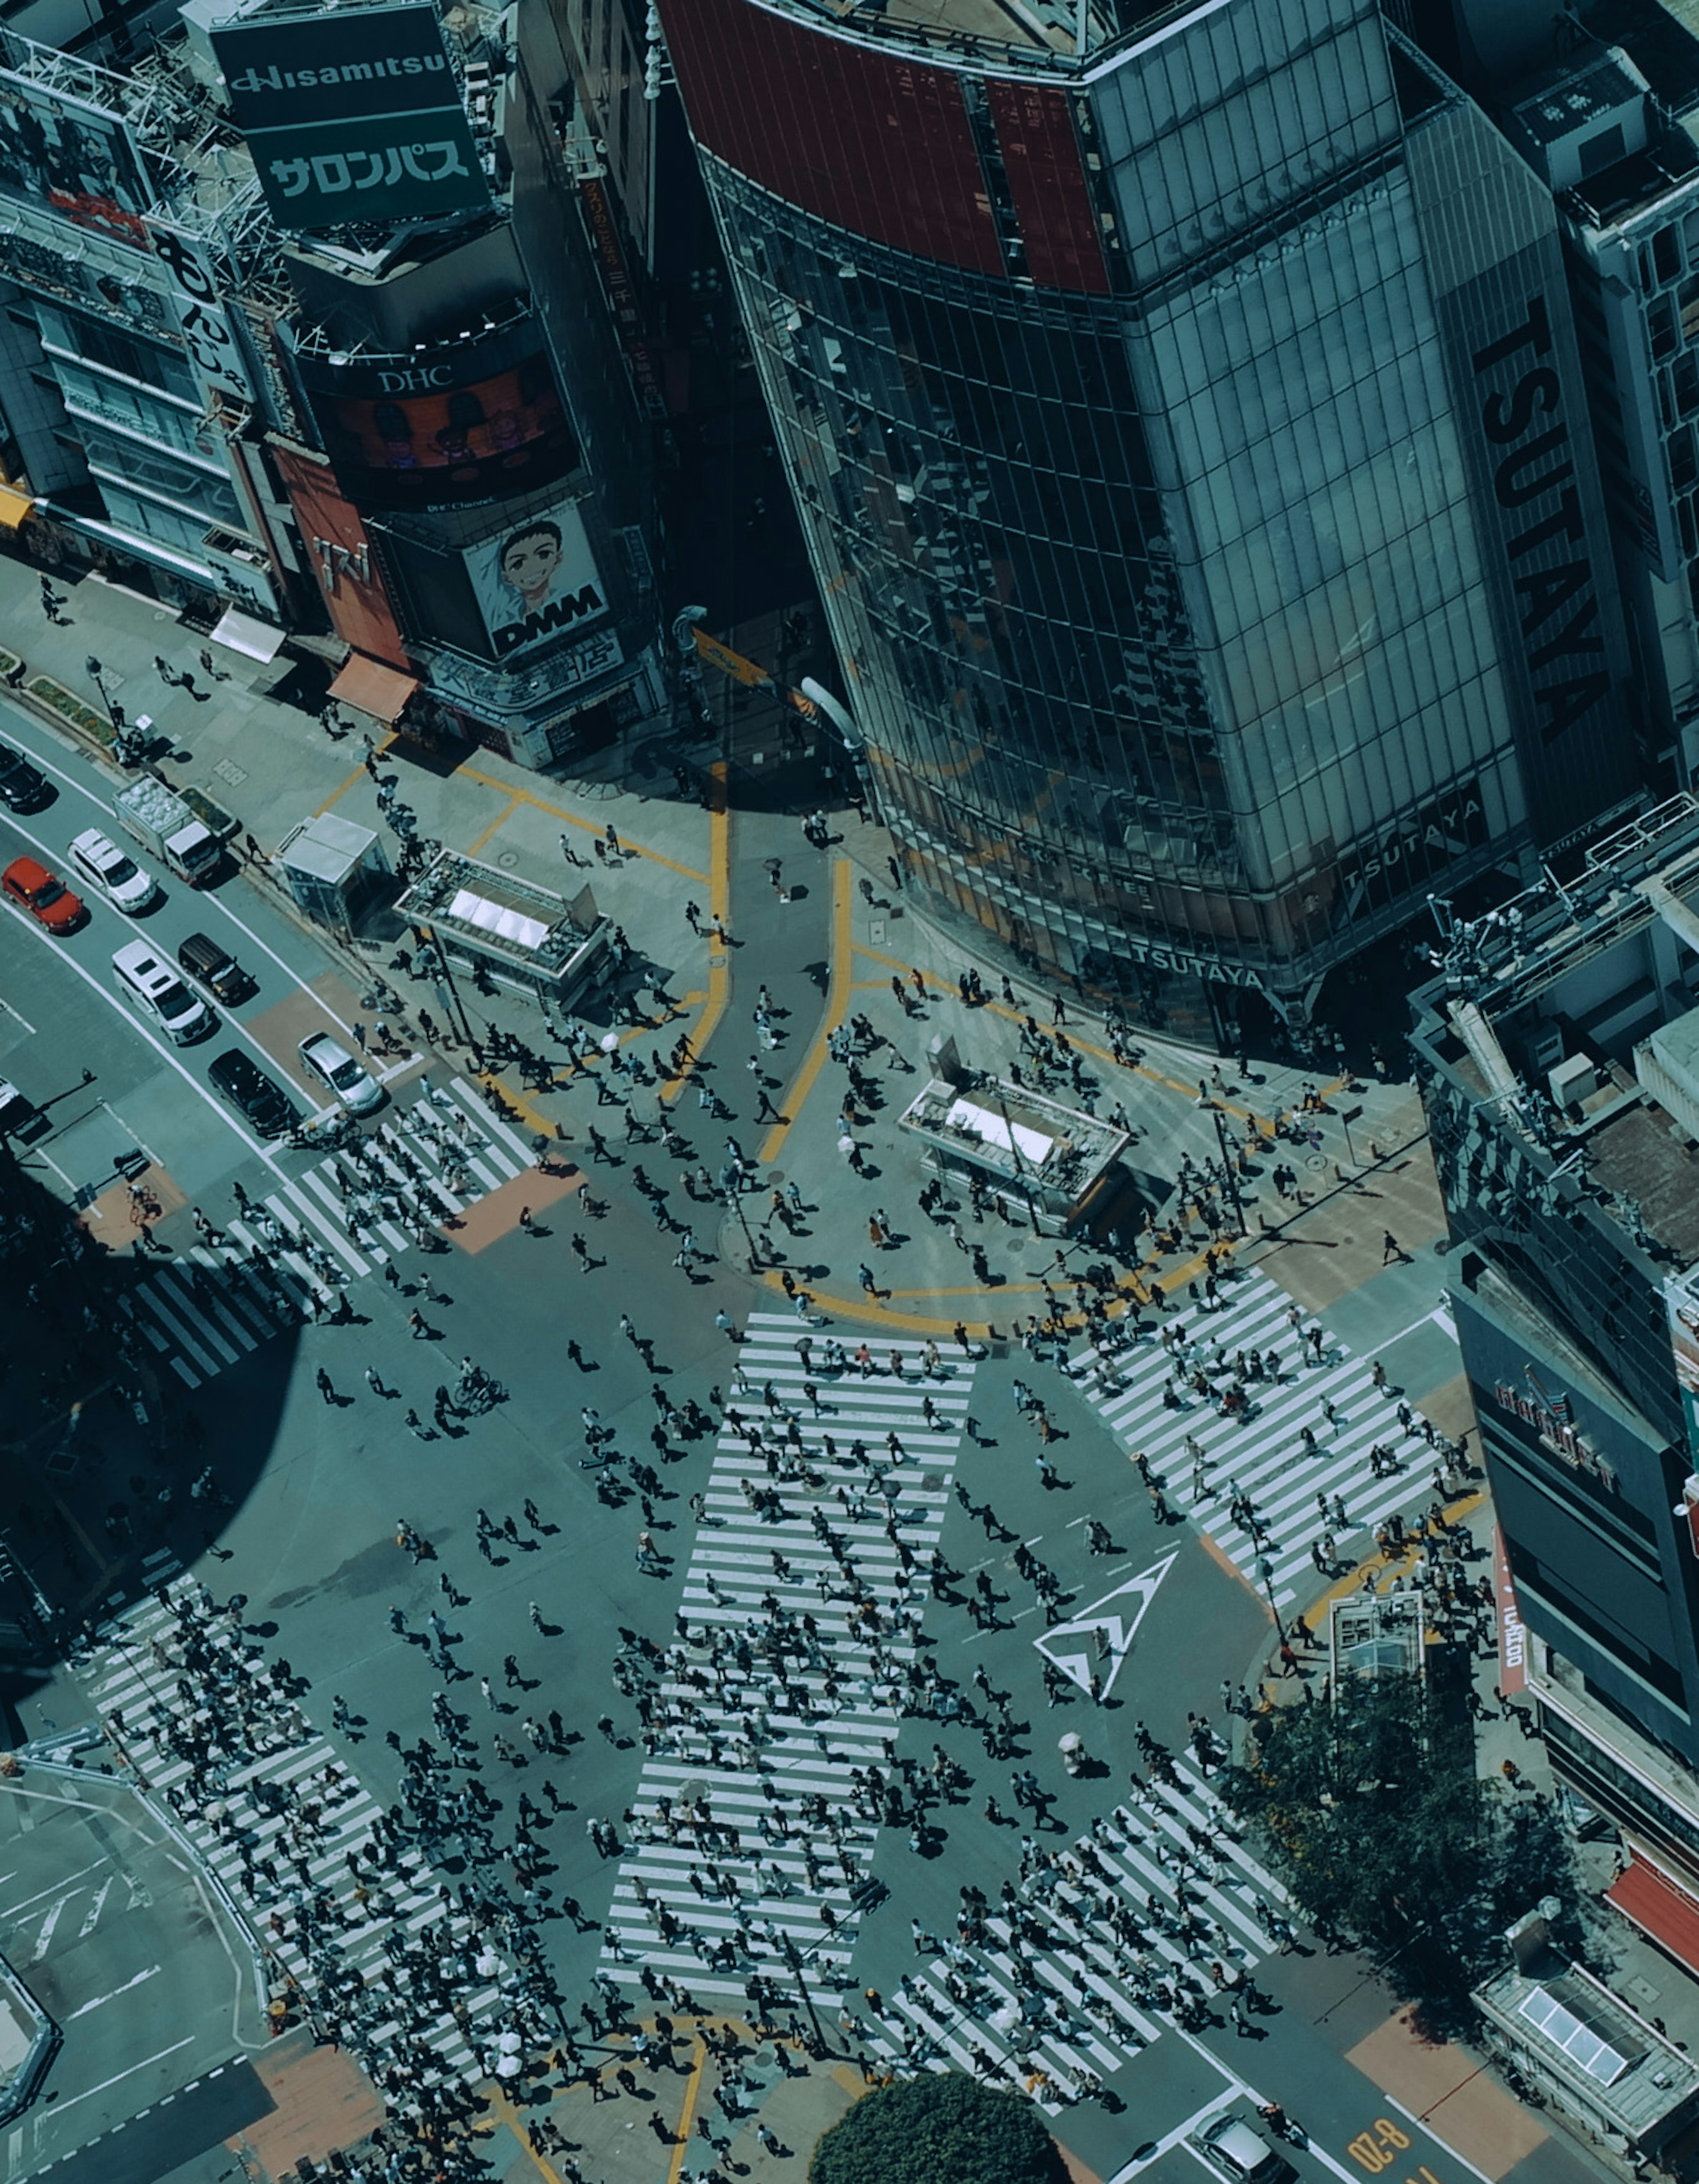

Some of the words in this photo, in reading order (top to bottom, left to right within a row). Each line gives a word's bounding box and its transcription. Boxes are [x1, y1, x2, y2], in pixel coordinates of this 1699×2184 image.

[231, 54, 446, 93] Hisamitsu
[269, 140, 469, 198] サロンパス
[377, 365, 455, 393] DHC
[1472, 295, 1612, 748] TSUTAYA
[492, 584, 603, 656] DMM
[1344, 799, 1480, 890] TSUTAYA
[1131, 943, 1264, 990] TSUTAYA
